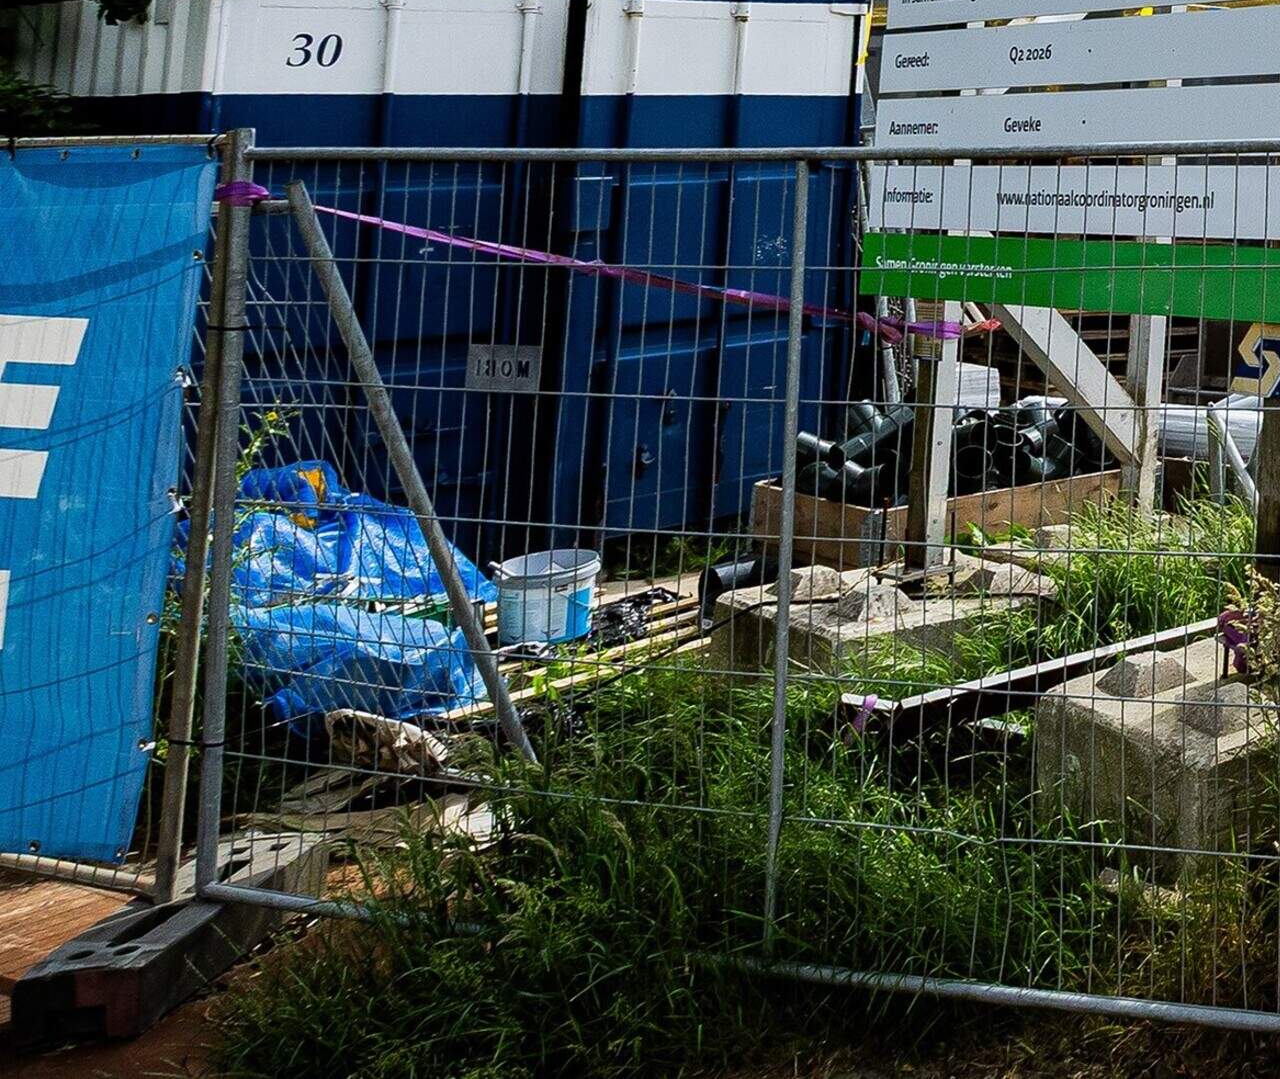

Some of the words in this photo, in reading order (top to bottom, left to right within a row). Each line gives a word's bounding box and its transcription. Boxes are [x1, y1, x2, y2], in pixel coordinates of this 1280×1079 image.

[285, 33, 343, 68] 30
[895, 54, 930, 70] Gereed:
[1009, 46, 1025, 63] Q2
[1026, 45, 1052, 61] 2026
[889, 120, 939, 135] Aannemer:
[1004, 117, 1041, 133] Geveke
[884, 189, 933, 204] Informatie:
